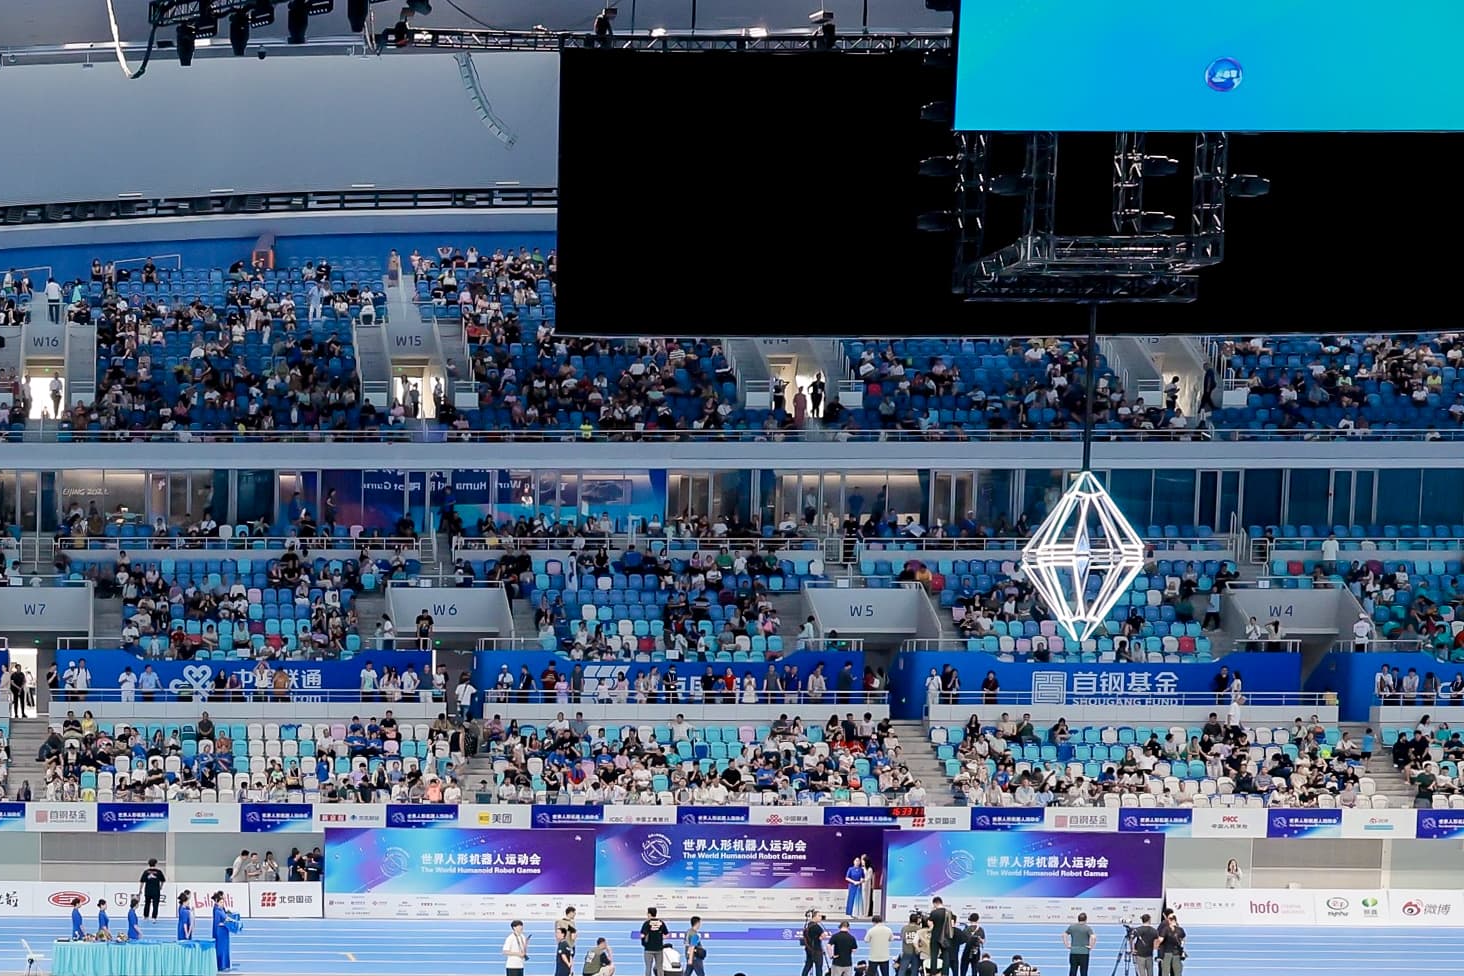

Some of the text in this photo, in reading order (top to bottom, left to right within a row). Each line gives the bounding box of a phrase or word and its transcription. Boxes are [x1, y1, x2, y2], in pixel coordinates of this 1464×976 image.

[32, 337, 59, 347] W16
[396, 335, 422, 346] W15
[24, 603, 46, 615] W7
[433, 604, 458, 616] W6
[850, 604, 874, 617] W5
[1269, 605, 1293, 617] W4
[1073, 671, 1180, 693] 首钢基金
[492, 814, 512, 824] 美团
[683, 839, 808, 852] 世界人形机器人运动会
[421, 853, 542, 866] 世界人形机器人运动会
[683, 851, 807, 860] The World Humanoid Robot Games
[986, 856, 1109, 868] 世界人形机器人运动会
[435, 866, 457, 875] World
[457, 866, 493, 875] Humanoid
[495, 866, 515, 875] Robot
[516, 866, 541, 875] Games
[1001, 869, 1022, 878] World
[1023, 869, 1059, 878] Humanoid
[1060, 869, 1083, 878] Robot
[1083, 869, 1109, 878] Games
[279, 895, 313, 904] 北京国资
[1250, 901, 1279, 913] hofo
[1424, 903, 1452, 915] 微博
